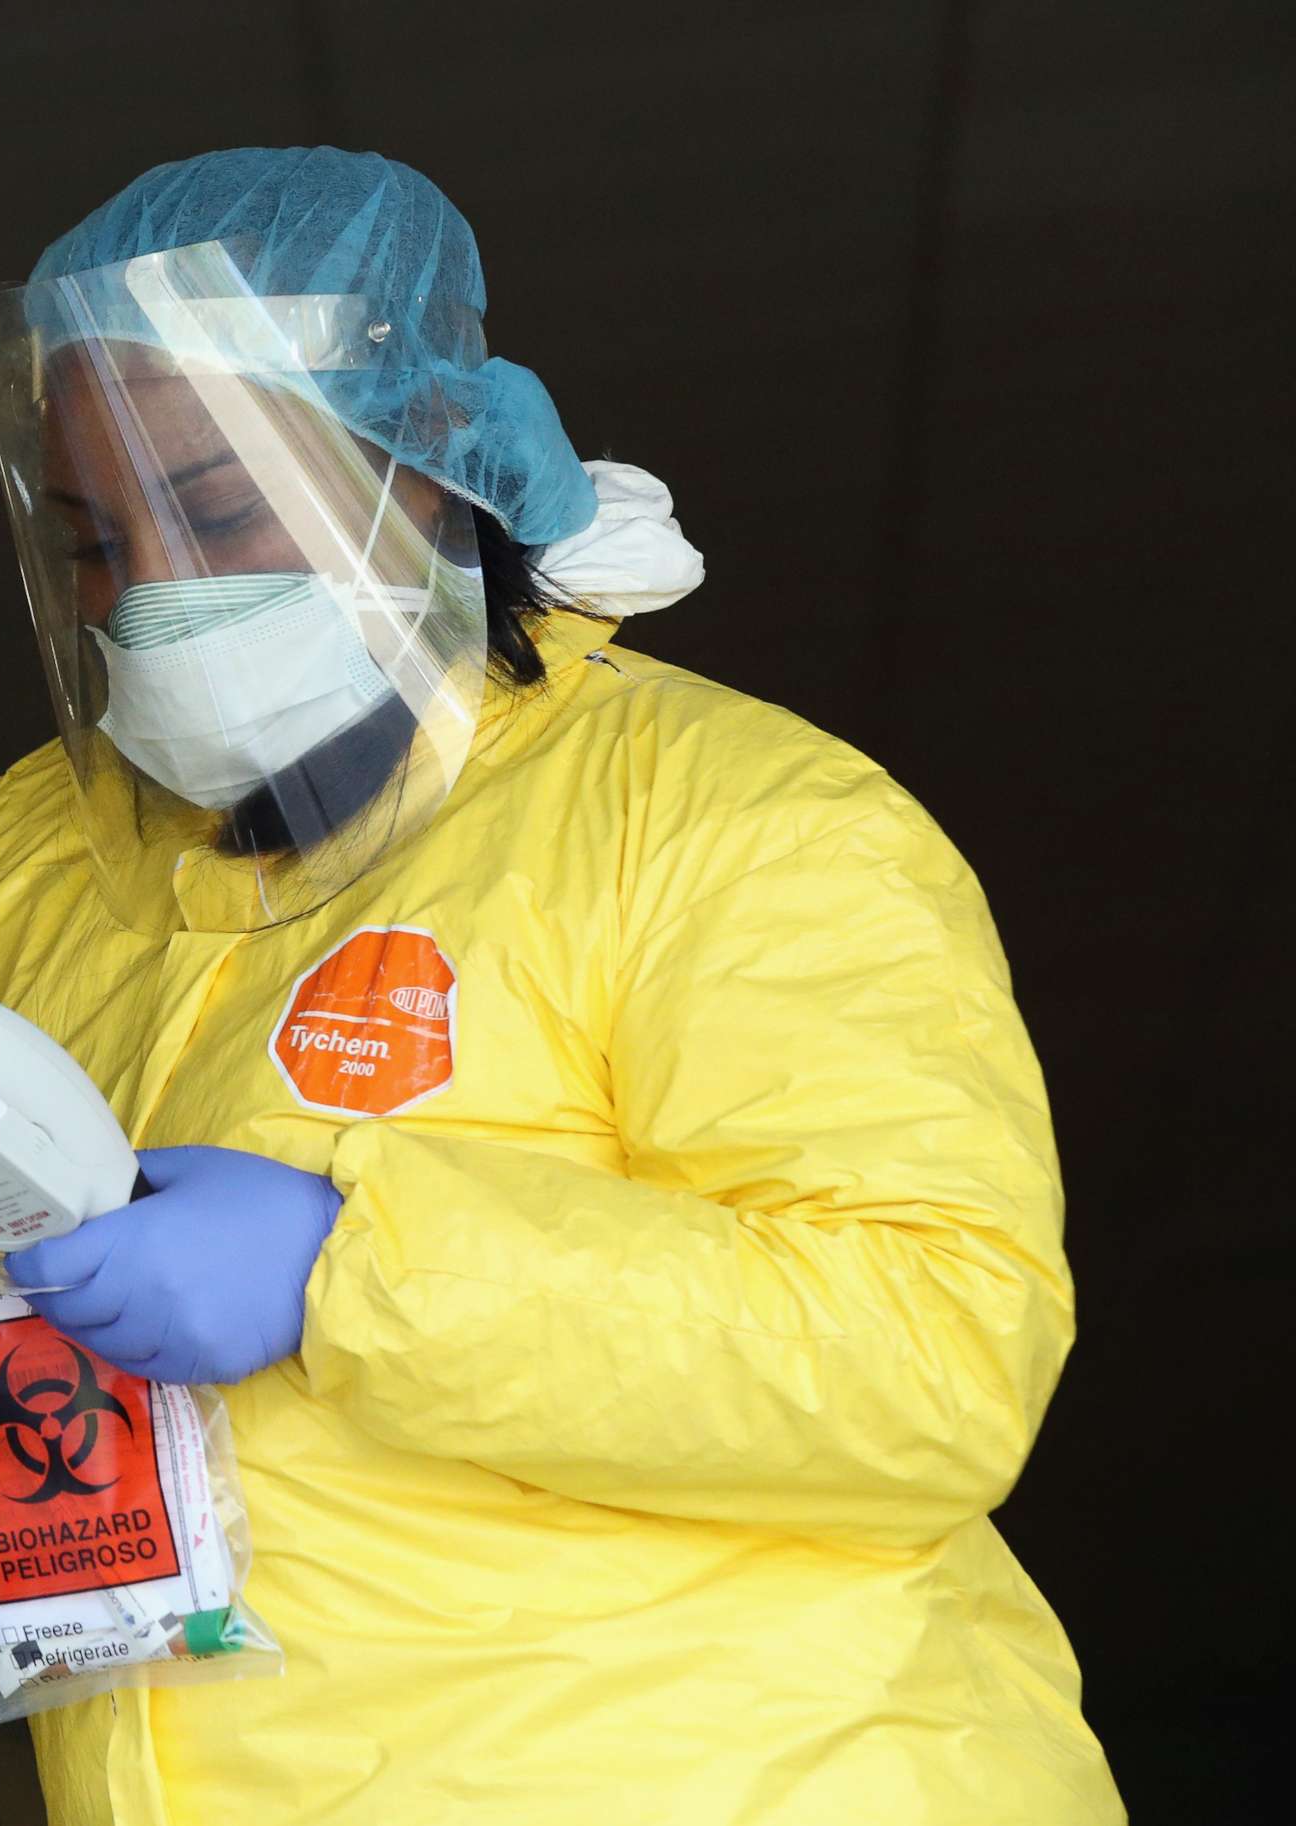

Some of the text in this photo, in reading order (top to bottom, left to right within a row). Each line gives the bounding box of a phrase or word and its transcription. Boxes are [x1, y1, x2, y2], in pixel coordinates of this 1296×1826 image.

[290, 1025, 389, 1059] Tychem
[338, 1060, 375, 1077] 2000
[0, 1537, 157, 1582] PELIGROSO
[22, 1621, 84, 1643] Freeze
[31, 1641, 129, 1668] Refrigerate
